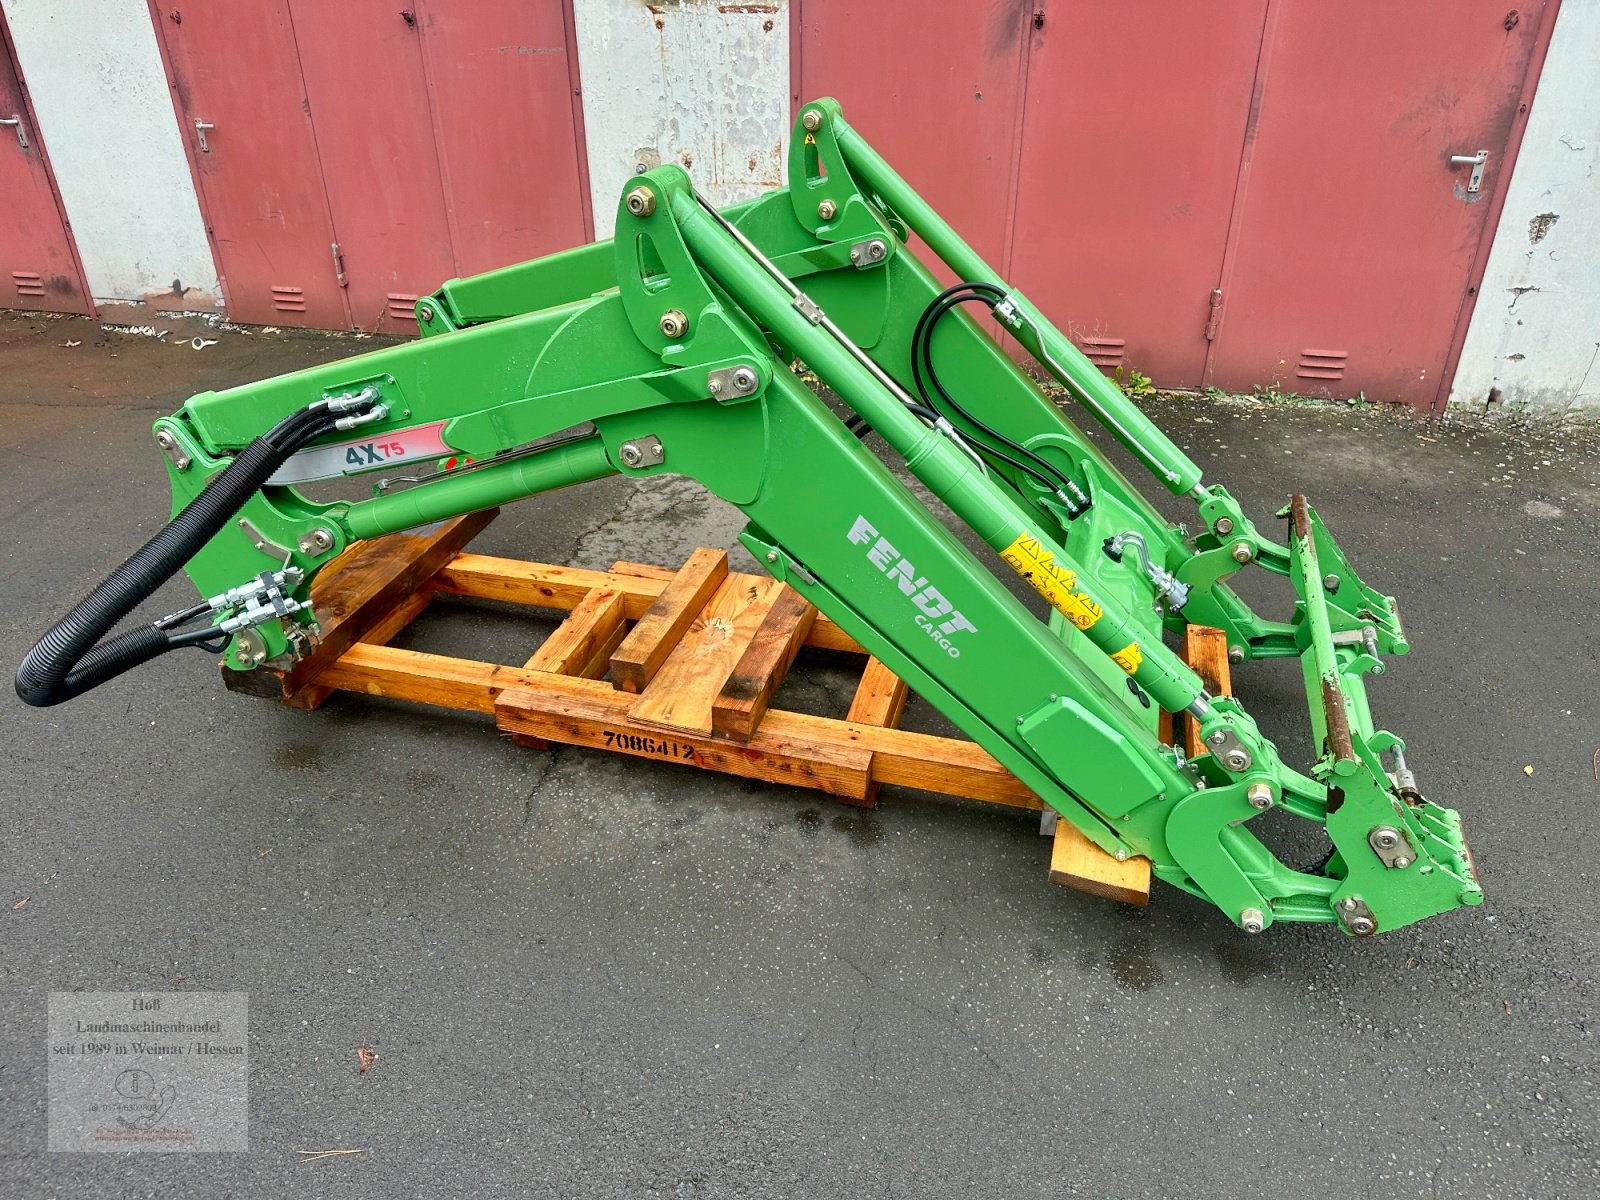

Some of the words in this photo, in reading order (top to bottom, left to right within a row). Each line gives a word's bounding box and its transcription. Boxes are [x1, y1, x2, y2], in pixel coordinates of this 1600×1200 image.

[846, 514, 978, 634] FENDT
[914, 614, 960, 659] CARGO
[603, 731, 694, 758] 7086412
